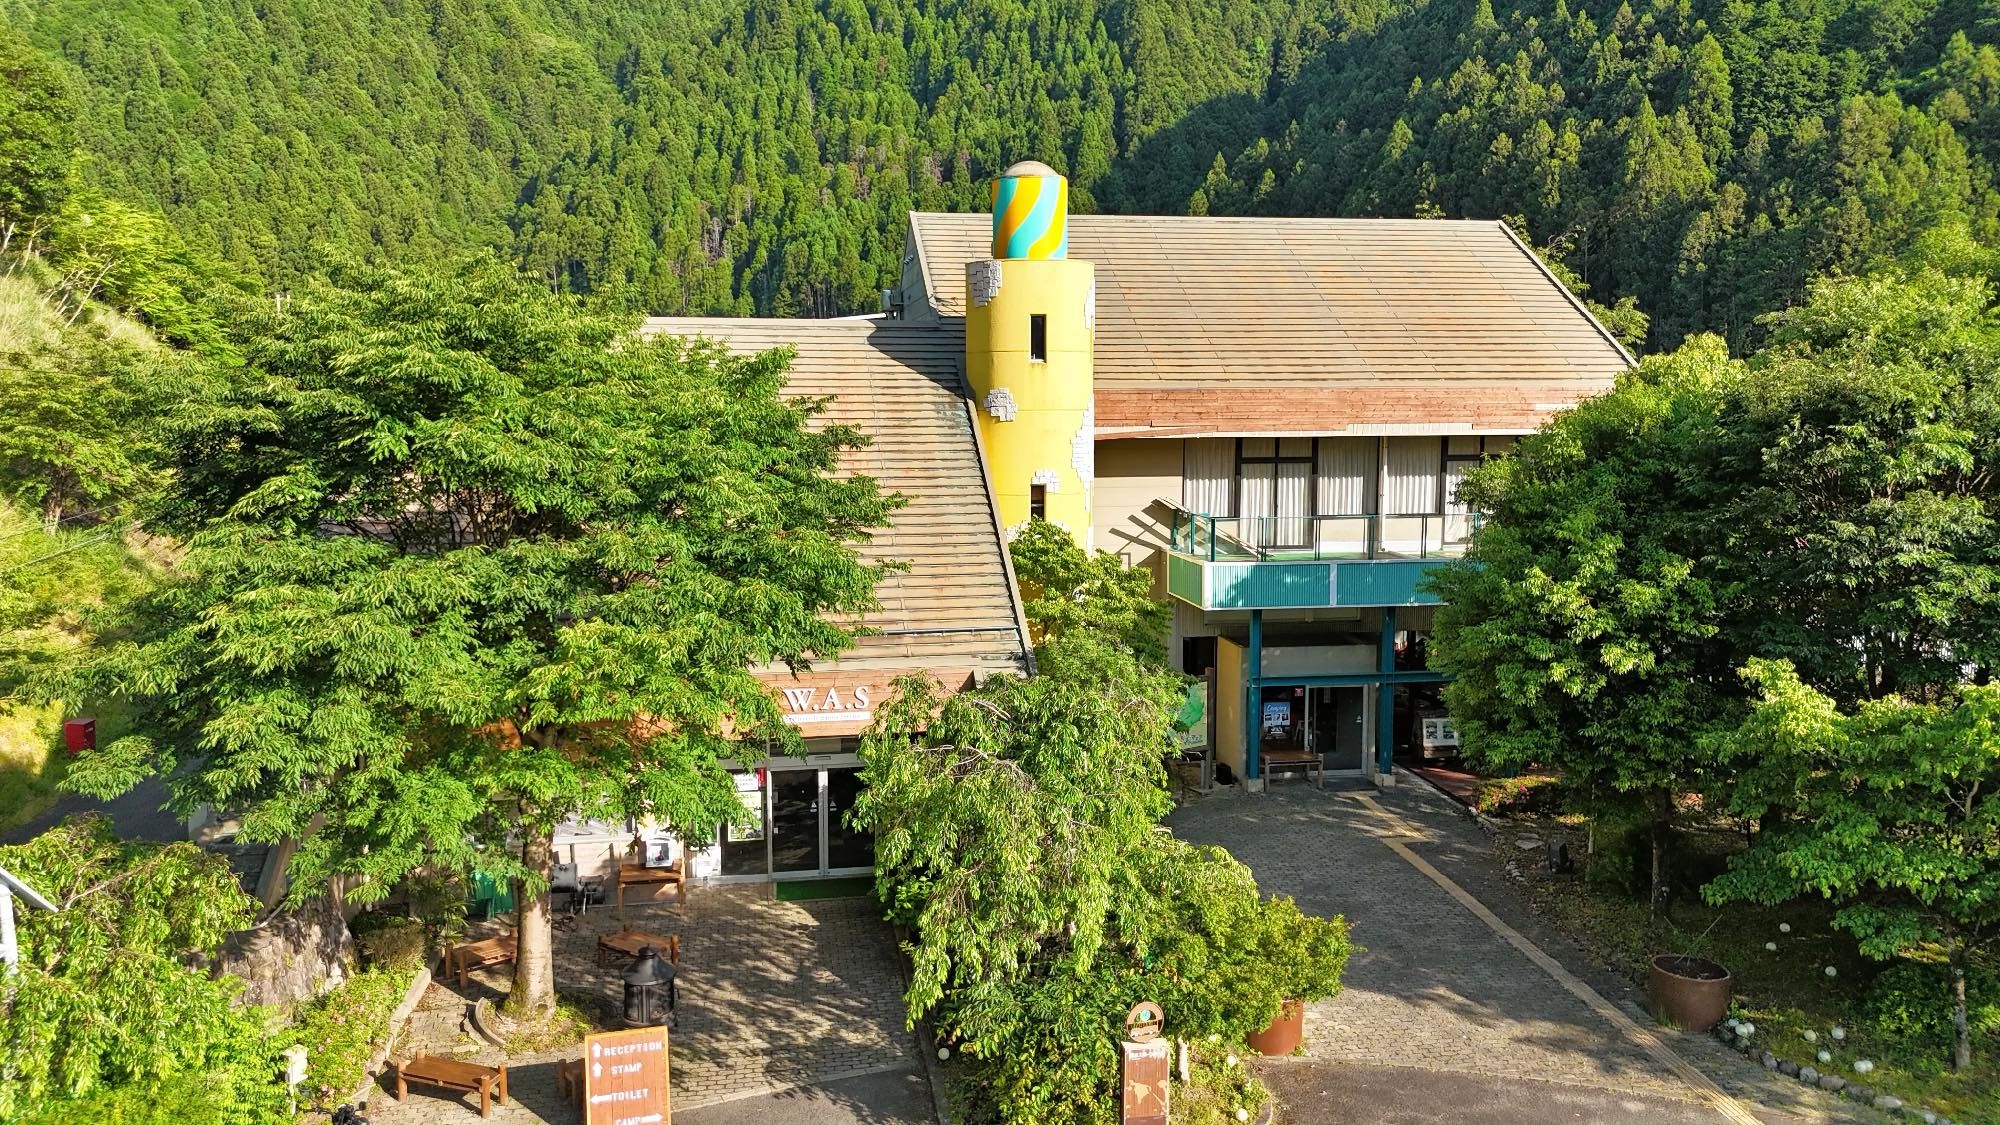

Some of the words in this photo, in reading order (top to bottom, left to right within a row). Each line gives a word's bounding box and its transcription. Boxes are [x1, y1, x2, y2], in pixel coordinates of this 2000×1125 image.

[783, 686, 869, 711] W.A.S
[604, 1041, 662, 1056] RECEPTION
[611, 1062, 642, 1074] STAMP
[612, 1089, 648, 1101] TOILET
